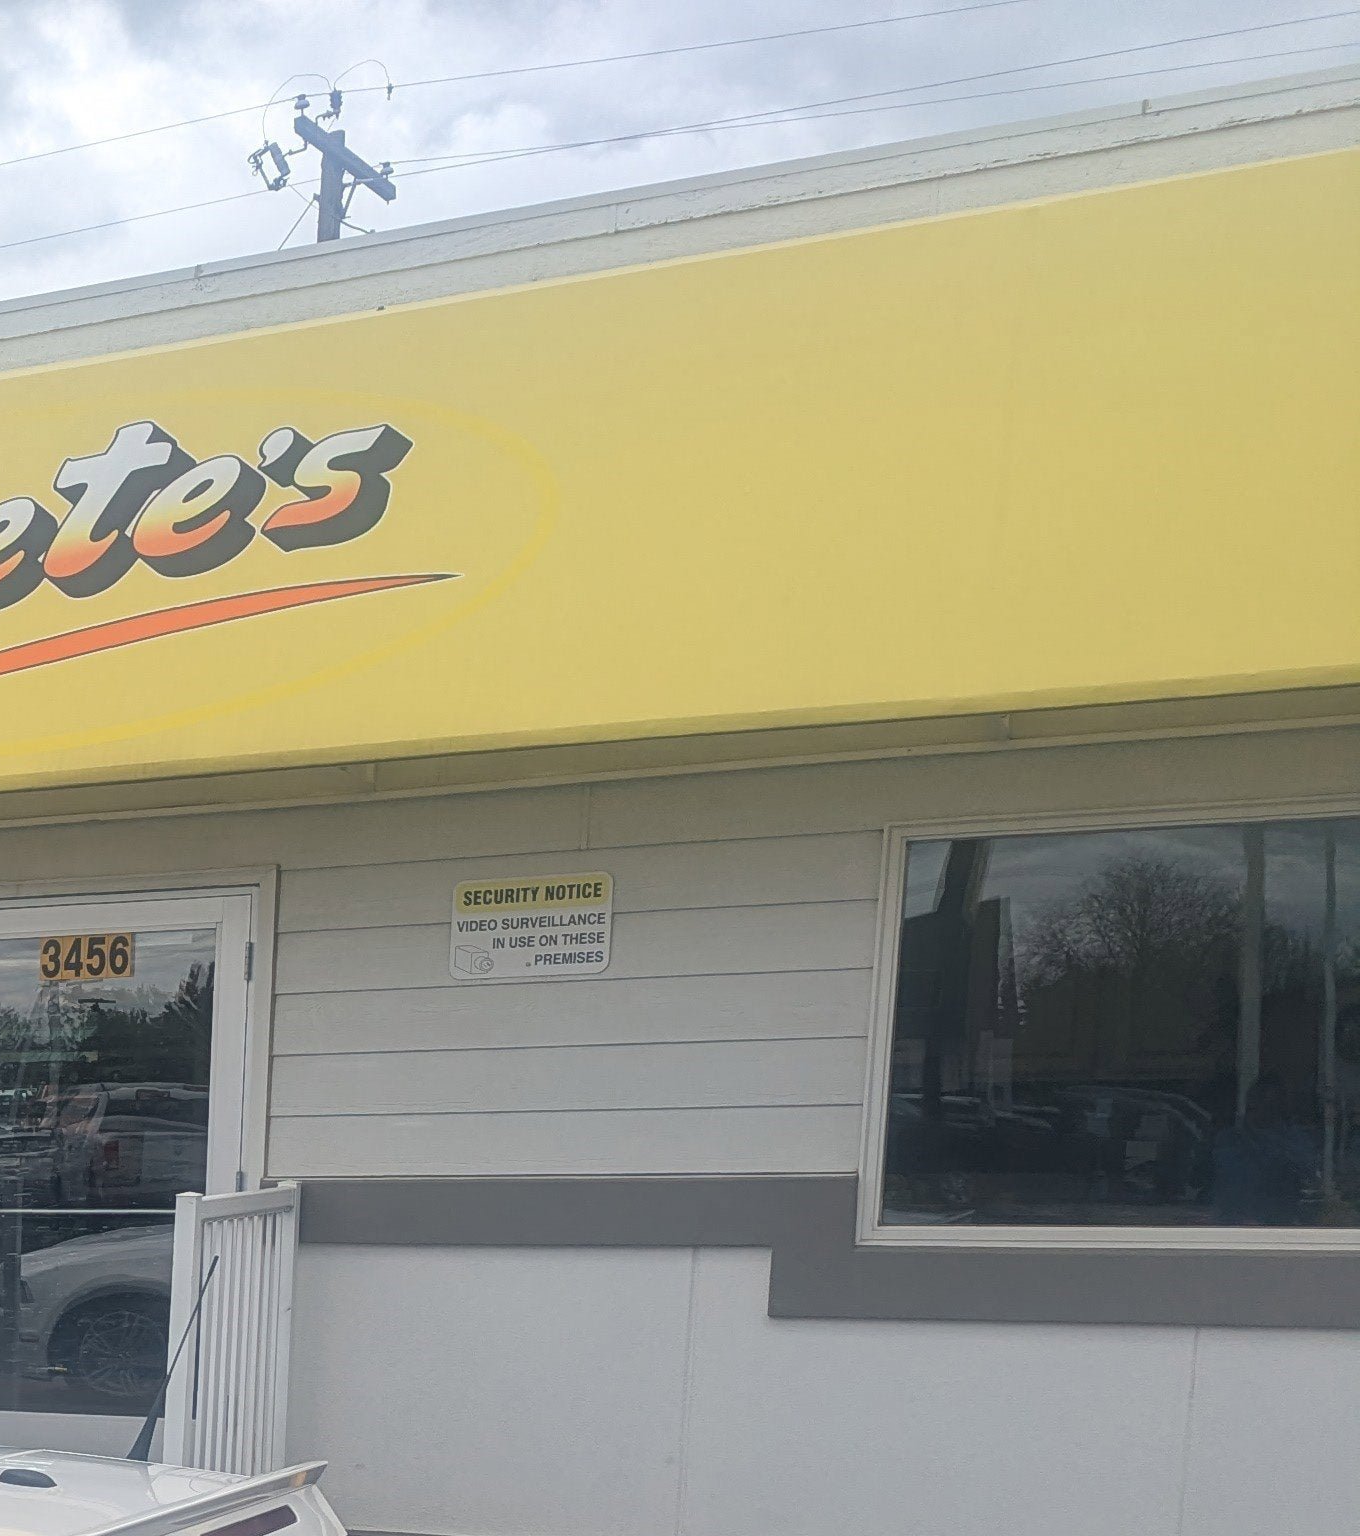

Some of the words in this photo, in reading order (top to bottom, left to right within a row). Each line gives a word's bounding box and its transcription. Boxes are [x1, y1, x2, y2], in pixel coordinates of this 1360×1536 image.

[462, 886, 540, 907] SECURITY
[544, 882, 603, 902] NOTICE
[456, 918, 498, 932] VIDEO
[501, 912, 606, 930] SURVEILLANCE
[492, 936, 506, 950] IN
[508, 935, 536, 949] USE
[538, 934, 558, 948] ON
[561, 931, 606, 946] THESE
[41, 934, 130, 979] 3456
[534, 950, 604, 966] PREMISES
